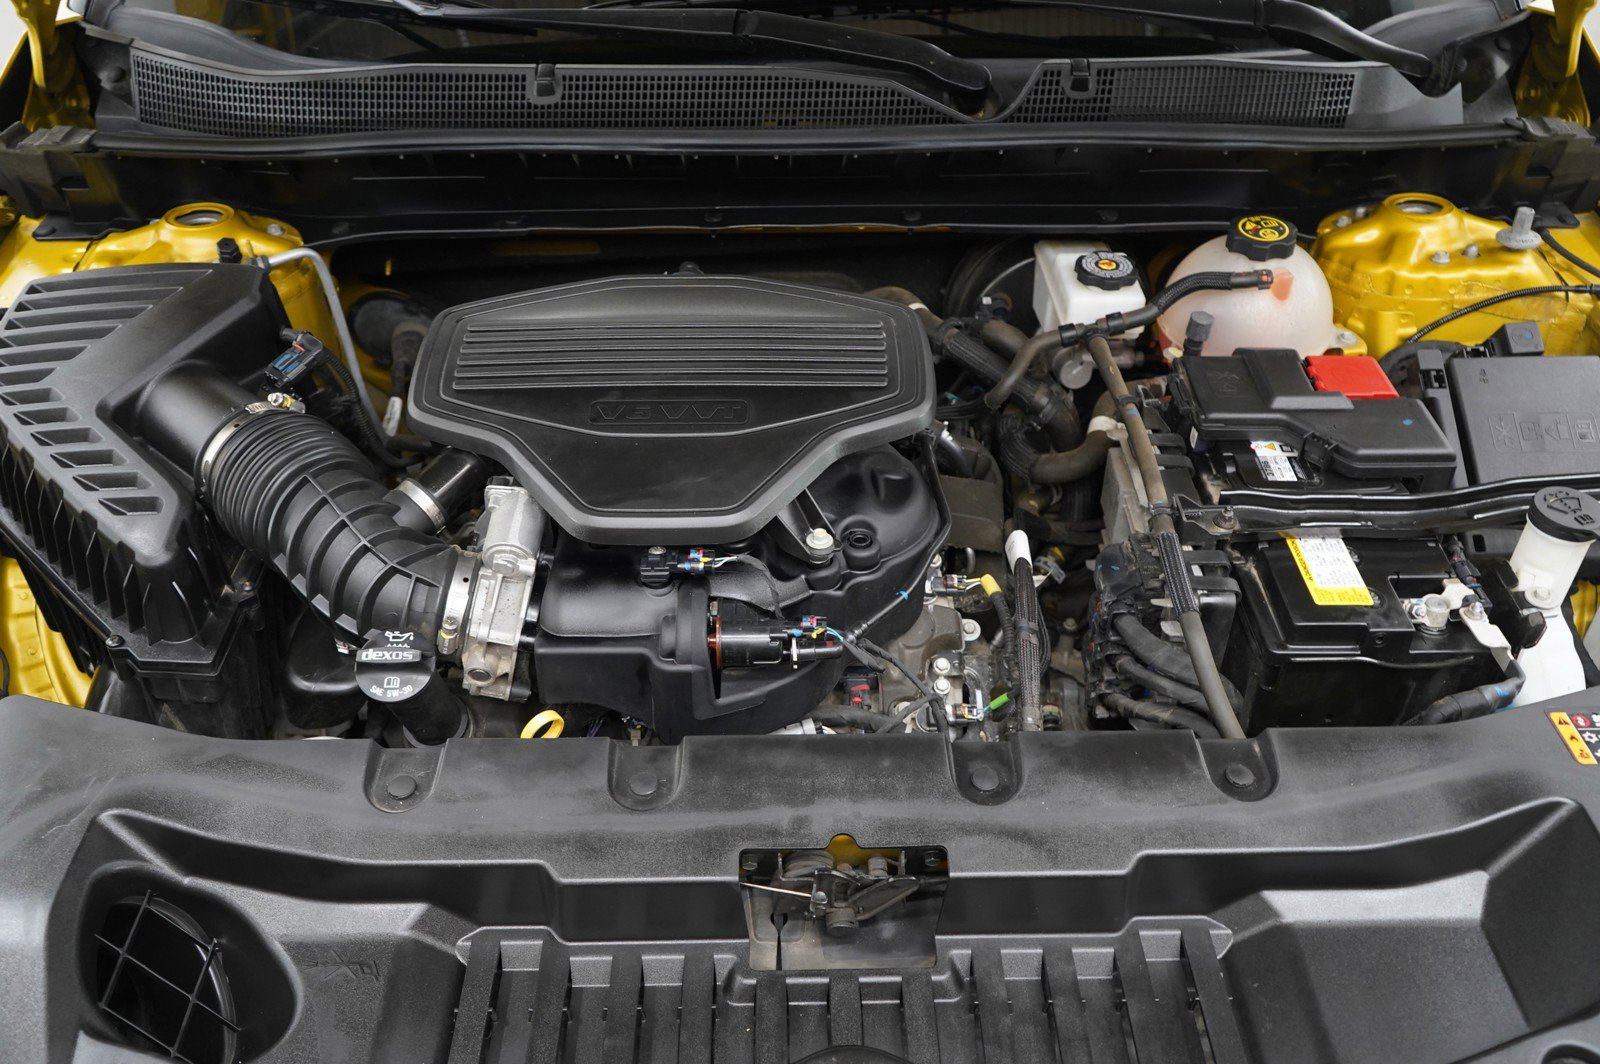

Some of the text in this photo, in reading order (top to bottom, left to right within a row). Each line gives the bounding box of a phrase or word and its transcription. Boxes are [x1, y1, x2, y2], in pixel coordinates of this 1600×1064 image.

[361, 649, 416, 661] dexos
[369, 684, 414, 698] SAE 5W-30
